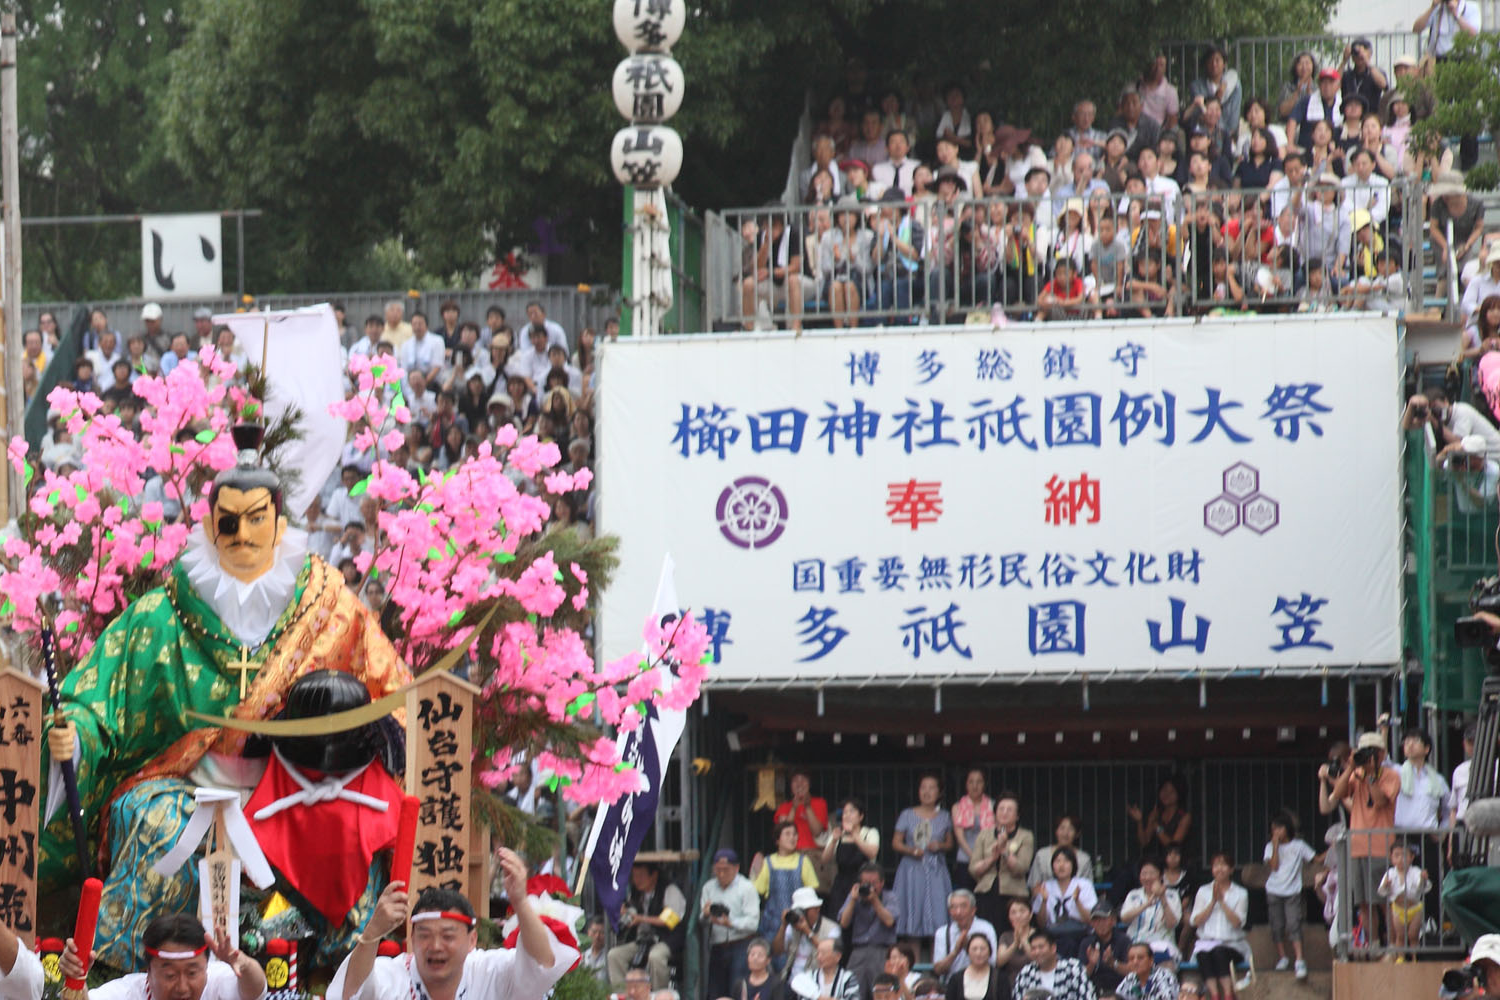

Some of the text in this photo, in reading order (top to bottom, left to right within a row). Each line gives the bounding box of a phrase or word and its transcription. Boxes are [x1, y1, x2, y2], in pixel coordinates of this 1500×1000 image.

[150, 227, 215, 293] い
[843, 341, 1146, 387] 博多総鎮守
[670, 382, 1333, 462] 櫛田神社祇園例大祭
[886, 473, 1101, 530] 奉納
[792, 550, 1205, 594] 国重要無形民俗文化財
